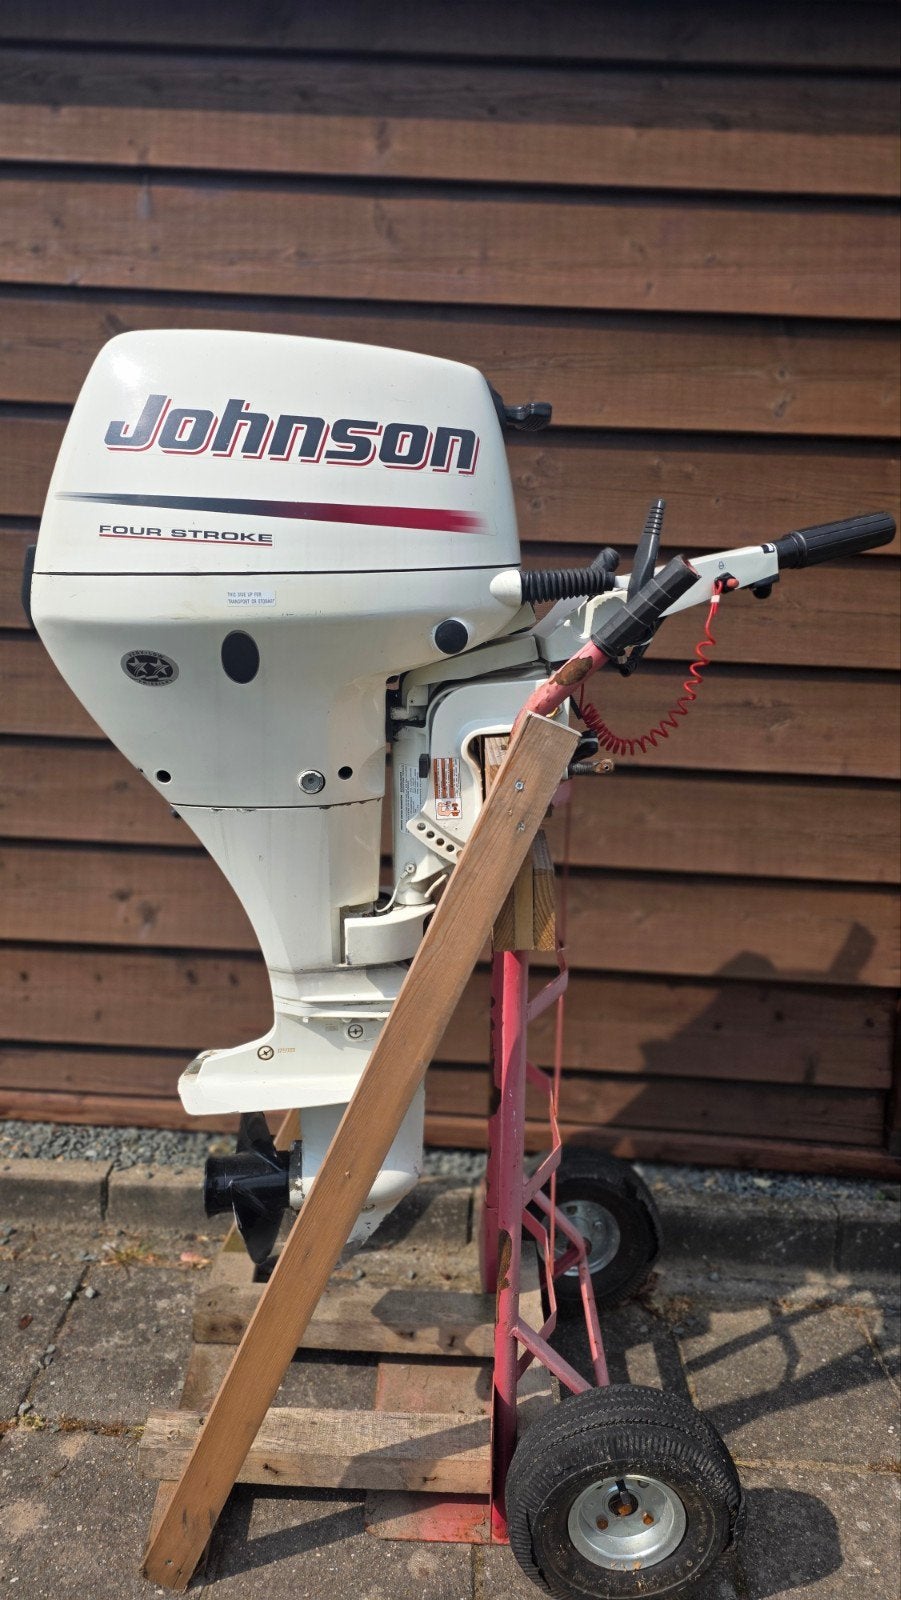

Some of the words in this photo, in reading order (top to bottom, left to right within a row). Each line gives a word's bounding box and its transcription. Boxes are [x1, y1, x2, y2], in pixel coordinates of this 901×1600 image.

[104, 393, 480, 476] Johnson
[99, 525, 162, 537] FOUR
[170, 529, 273, 543] STROKE
